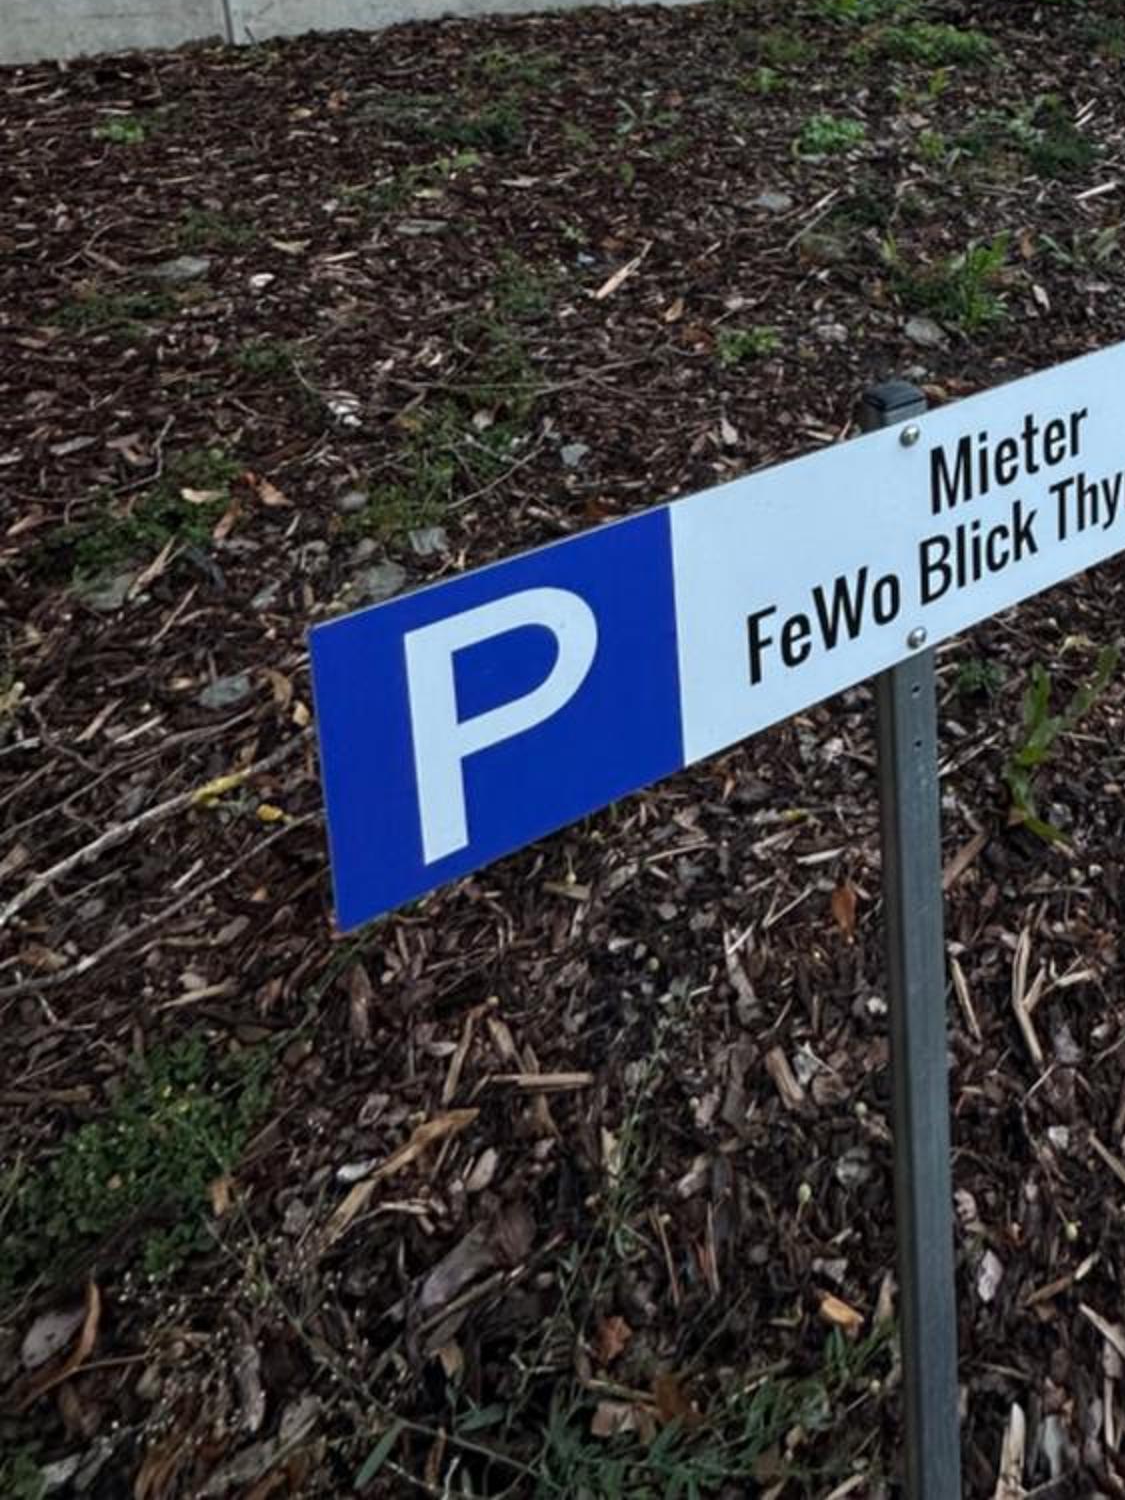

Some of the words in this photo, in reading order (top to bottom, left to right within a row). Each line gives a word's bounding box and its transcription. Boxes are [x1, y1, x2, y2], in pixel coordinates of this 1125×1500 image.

[930, 407, 1088, 516] Mieter
[746, 566, 901, 686] FeWo
[919, 499, 1038, 606] Blick
[404, 587, 598, 865] P
